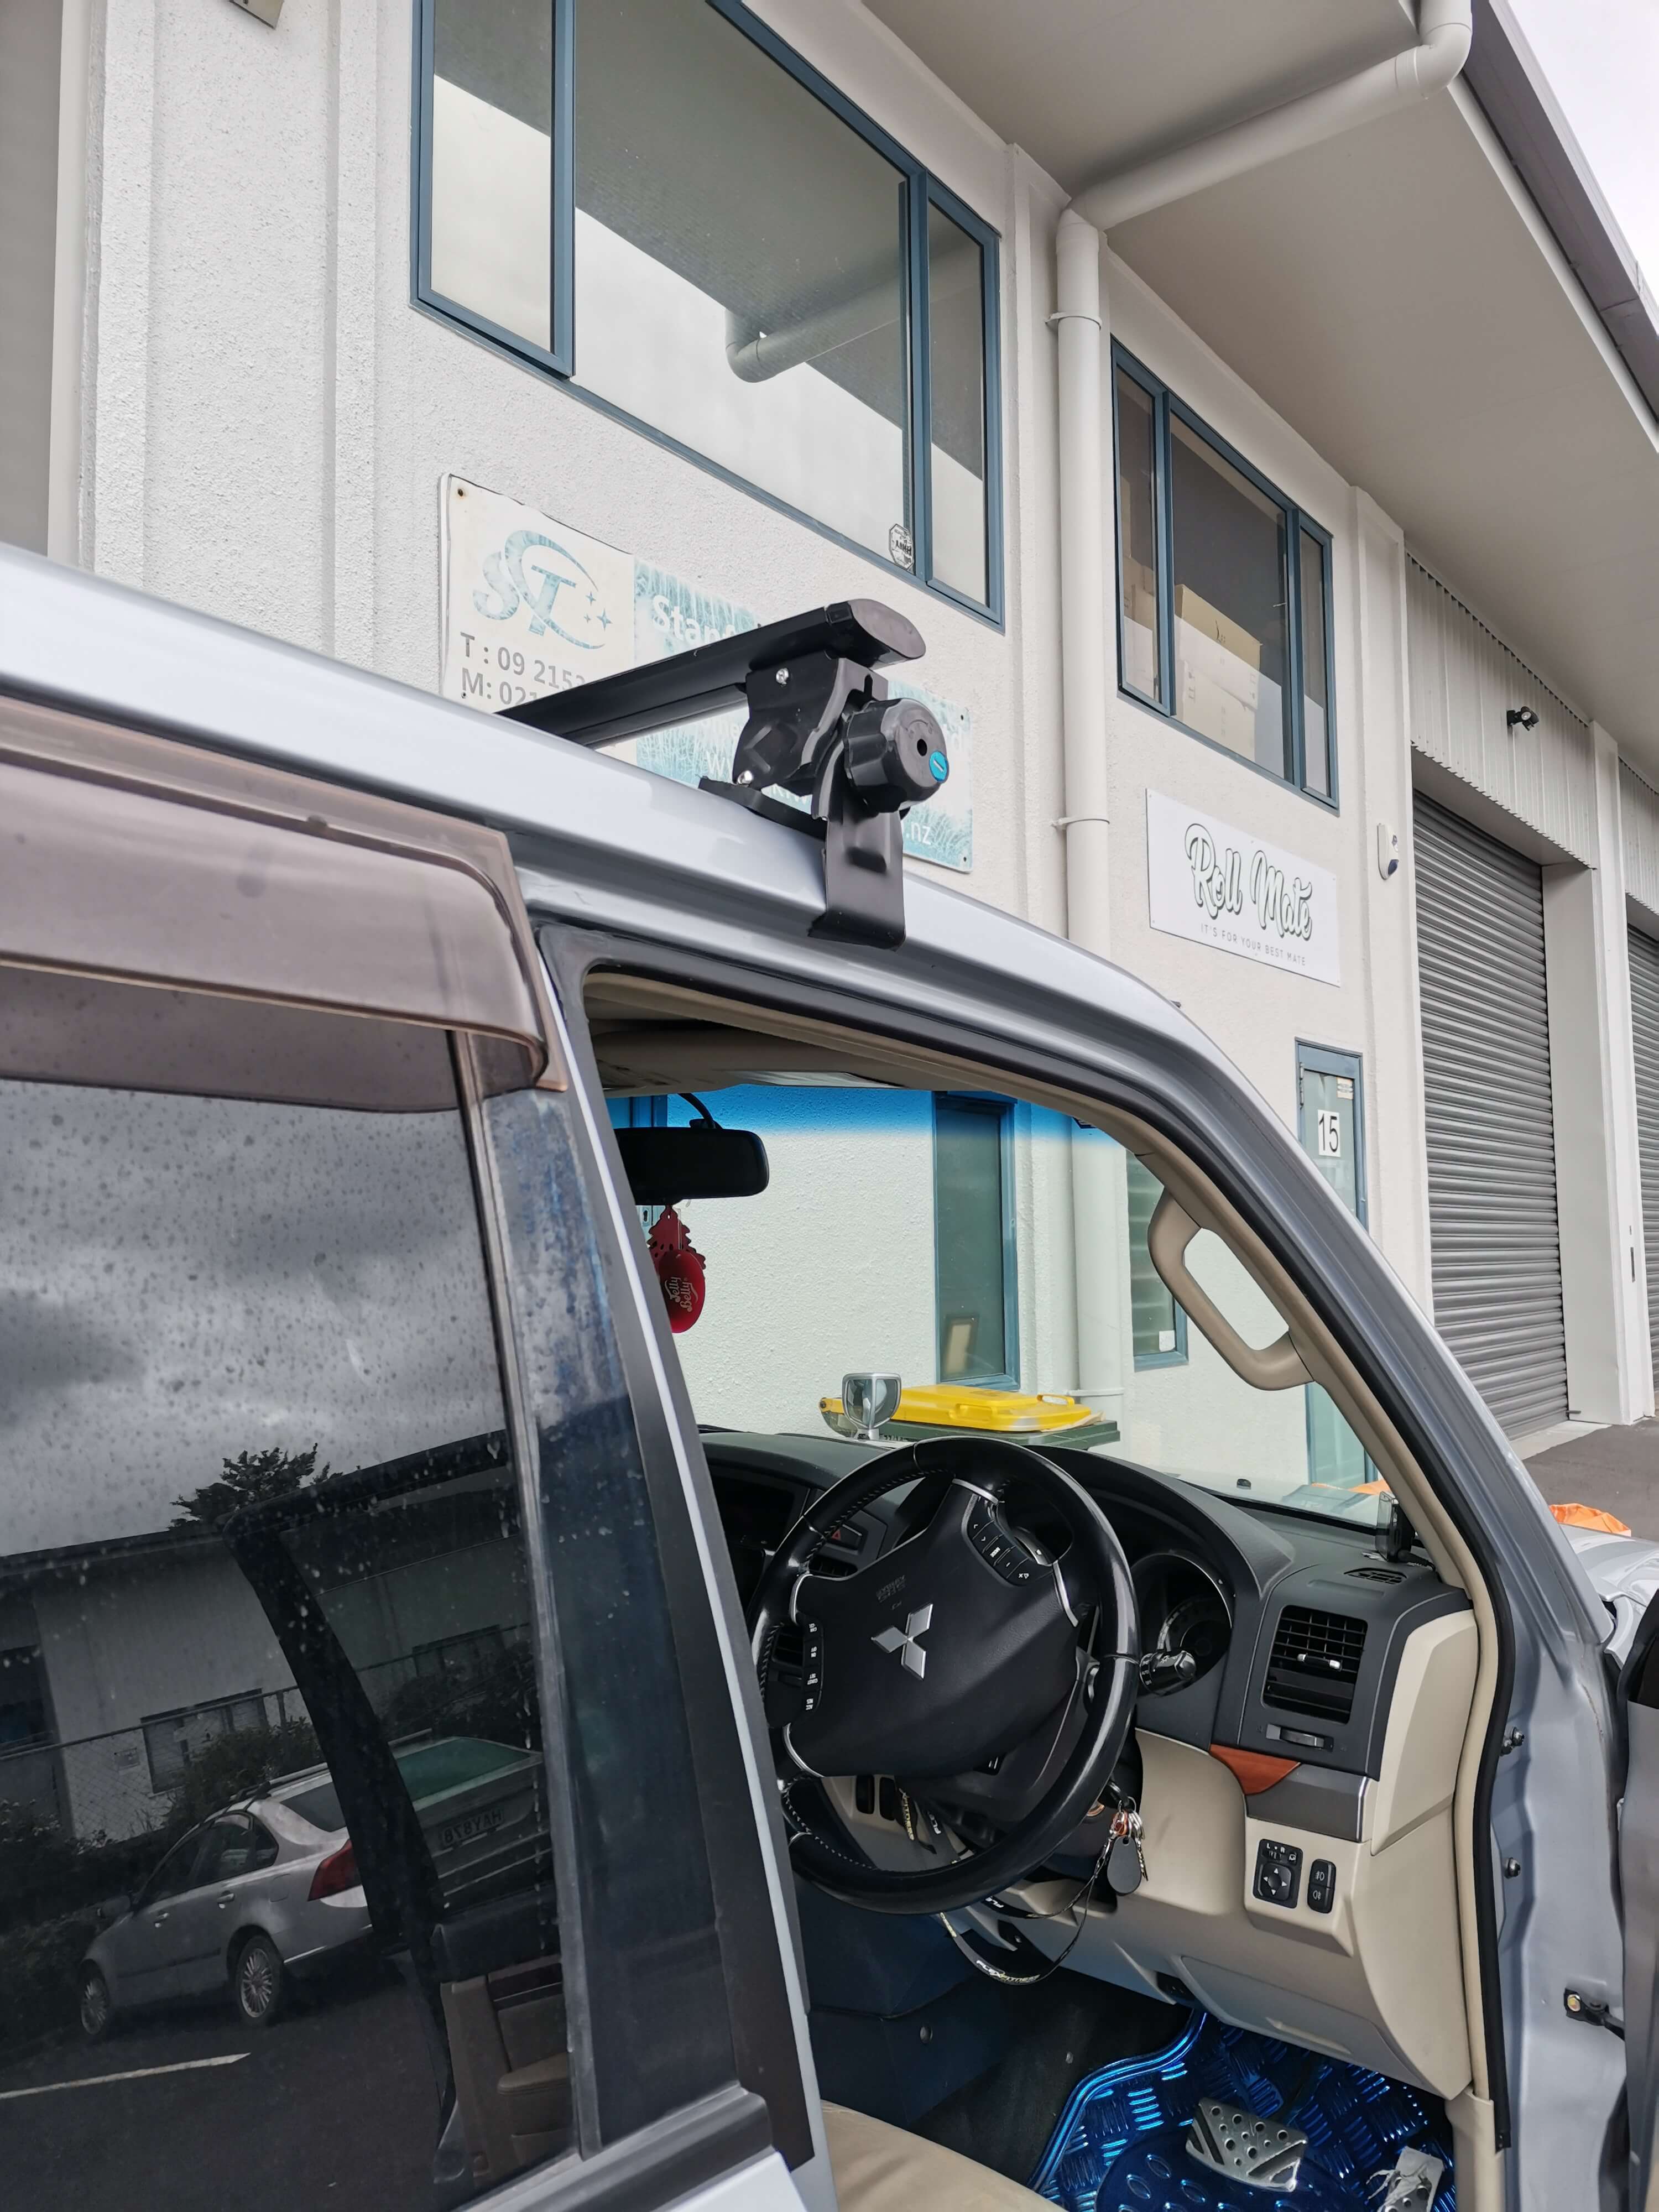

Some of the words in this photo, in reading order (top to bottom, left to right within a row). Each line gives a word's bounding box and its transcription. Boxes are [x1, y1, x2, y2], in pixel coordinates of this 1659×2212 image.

[497, 646, 525, 676] 09
[1185, 823, 1243, 920] Roll
[1250, 850, 1313, 941] Mate
[1201, 922, 1218, 937] IT'S
[1222, 930, 1238, 943] FOR
[1241, 937, 1261, 952] YOUR
[1265, 945, 1284, 959] BEST
[1287, 952, 1306, 966] MATE
[1319, 1113, 1339, 1152] 15
[679, 1281, 692, 1312] Belly
